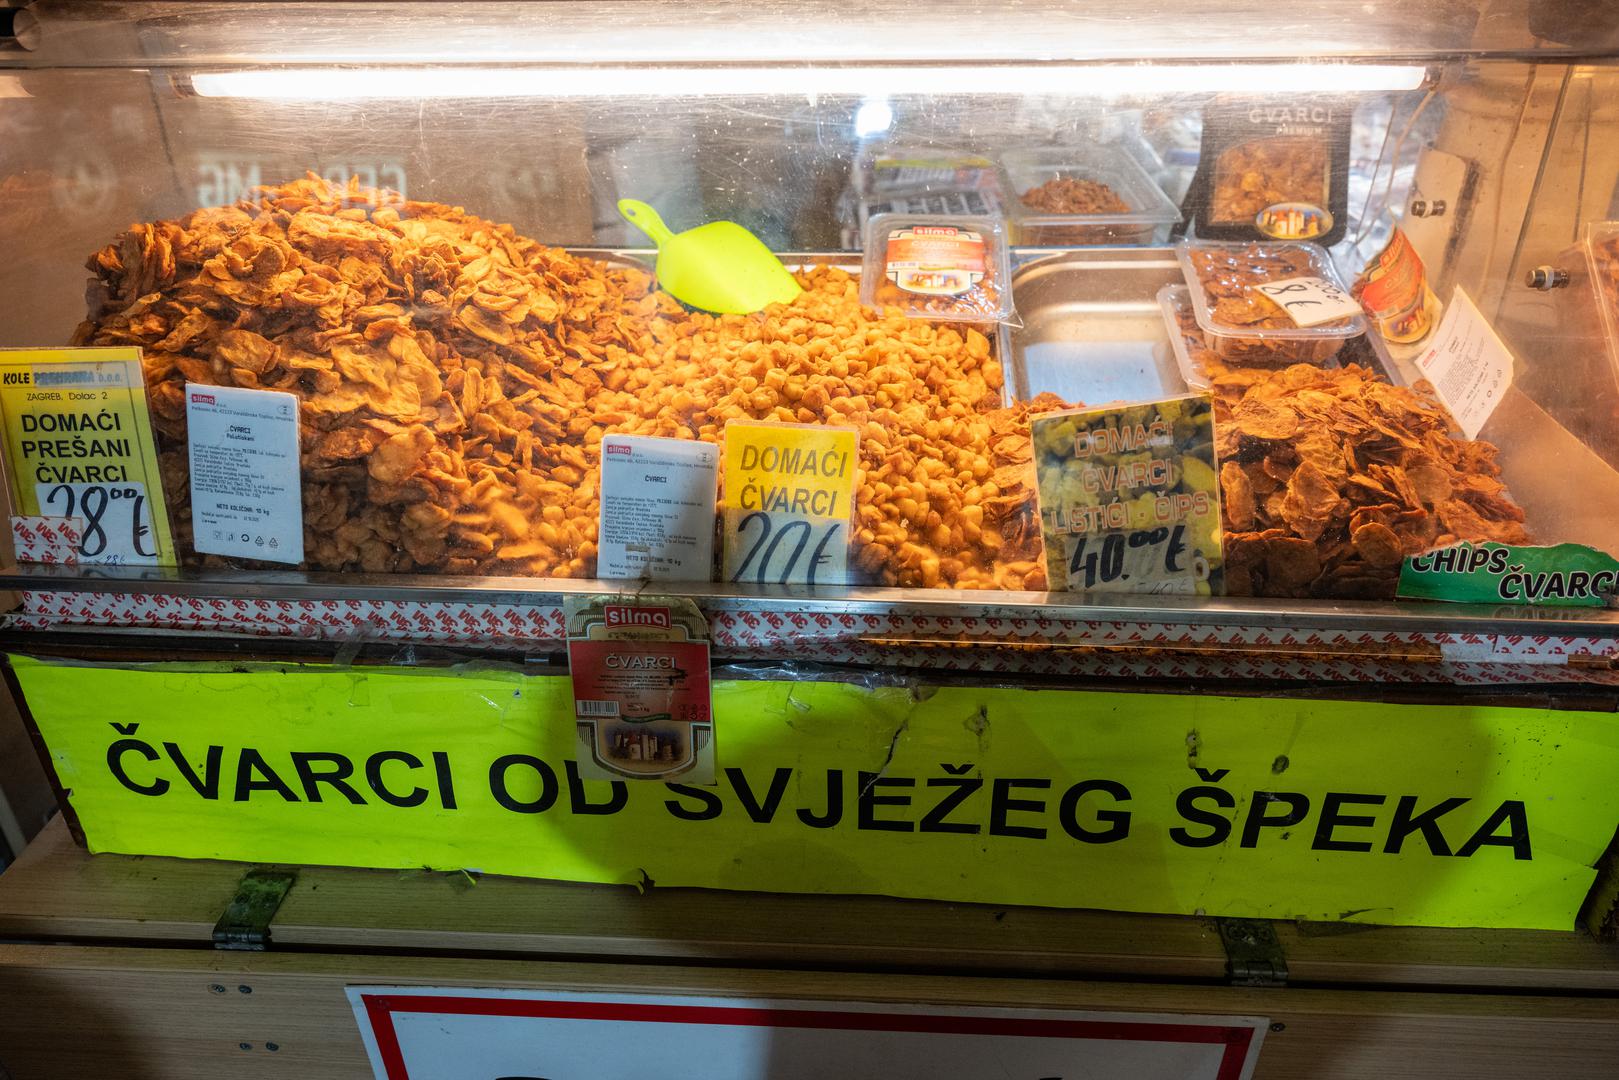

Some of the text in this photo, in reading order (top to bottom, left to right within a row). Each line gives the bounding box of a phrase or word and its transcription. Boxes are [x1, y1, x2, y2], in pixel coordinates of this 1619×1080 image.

[3, 372, 30, 385] KOLE
[68, 392, 97, 401] Dolac
[101, 391, 108, 400] 2
[21, 408, 121, 433] DOMAĆI
[21, 435, 131, 459] PREŠANI
[1074, 415, 1173, 458] DOMAĆI
[607, 445, 631, 454] silma
[740, 443, 848, 478] DOMAĆI
[35, 462, 128, 484] ČVARCI
[1081, 457, 1174, 494] ČVARCI
[740, 477, 838, 516] ČVARCI
[1050, 496, 1130, 535] LISTIĆI
[1154, 490, 1210, 521] ČIPS
[1411, 547, 1510, 574] CHIPS
[608, 608, 668, 626] silma
[605, 652, 676, 670] ČVARCI
[106, 722, 1533, 861] ČVARCI OD SVJEŽEG ŠPEKA
